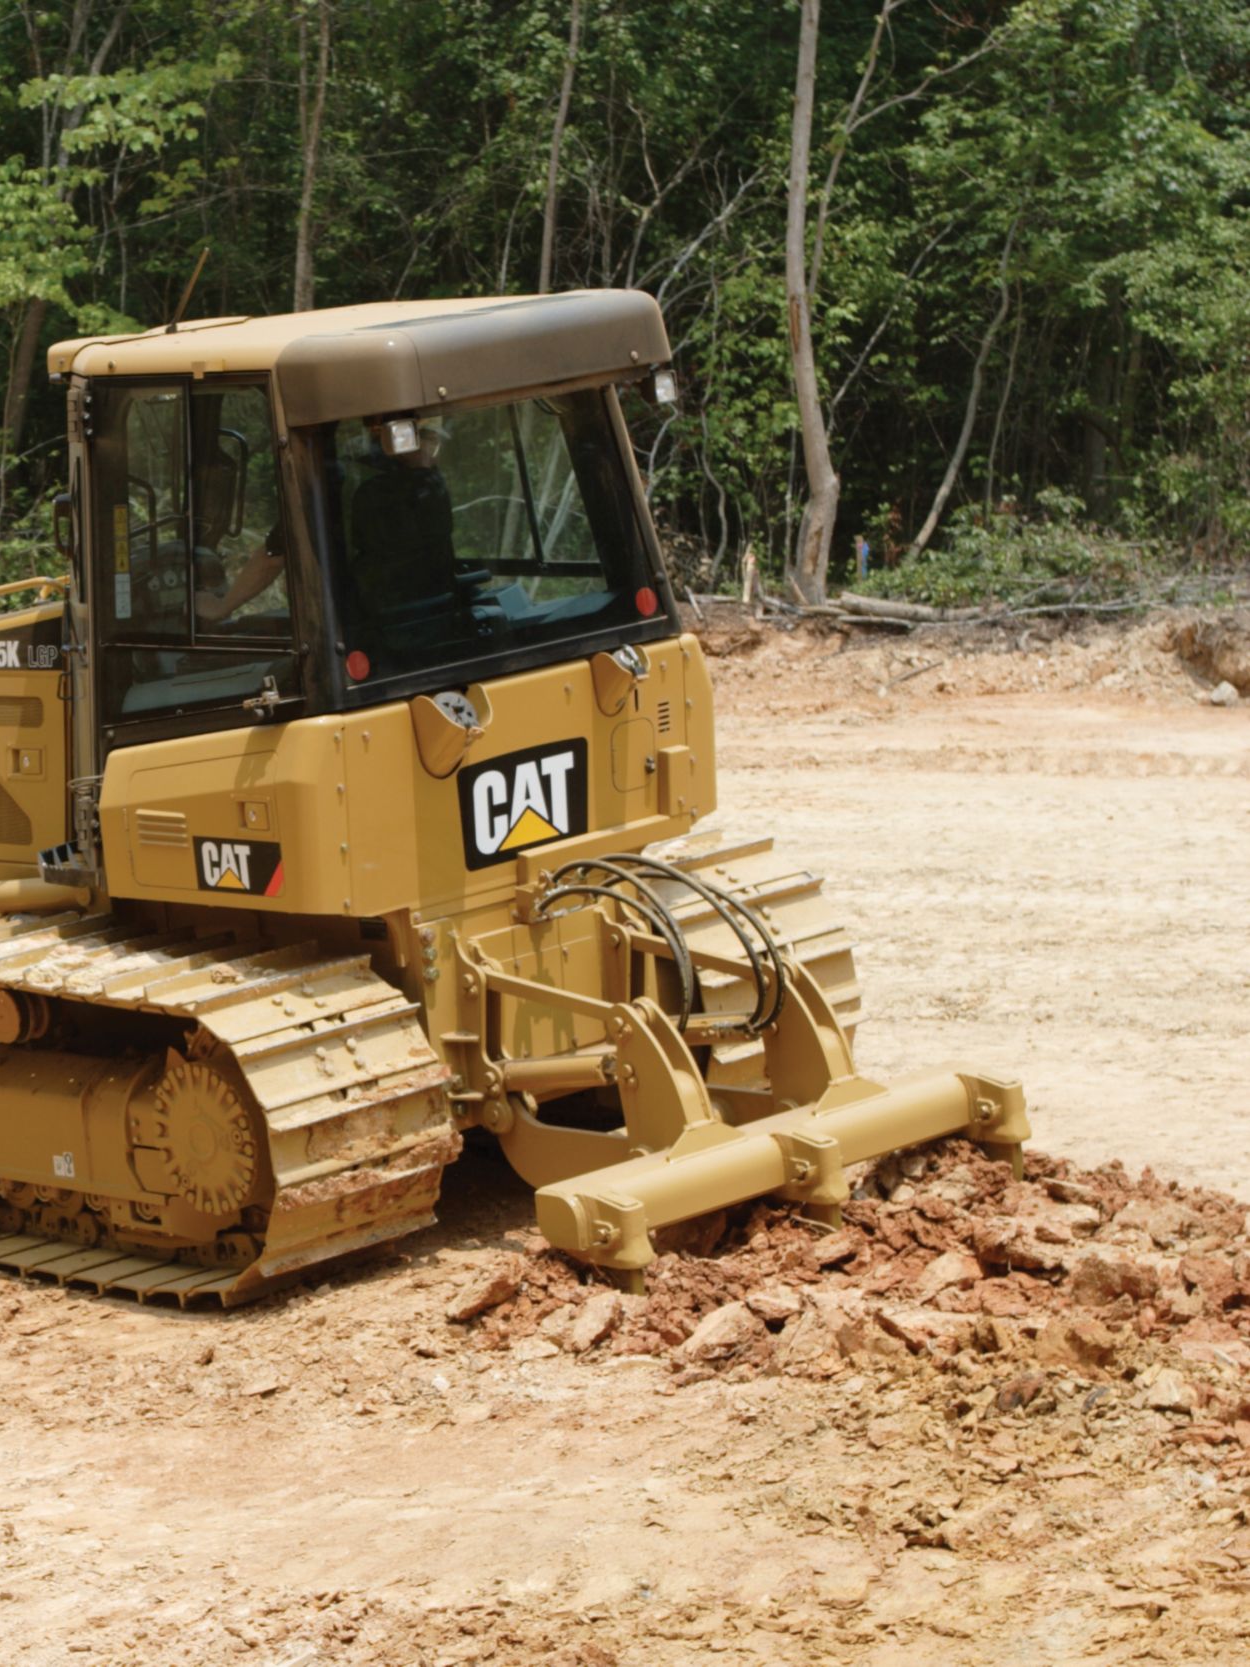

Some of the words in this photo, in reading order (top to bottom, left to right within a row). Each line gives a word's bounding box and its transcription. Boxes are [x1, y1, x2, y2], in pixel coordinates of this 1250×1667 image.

[27, 644, 58, 668] LGP
[472, 751, 574, 855] CAT
[201, 841, 251, 890] CAT
